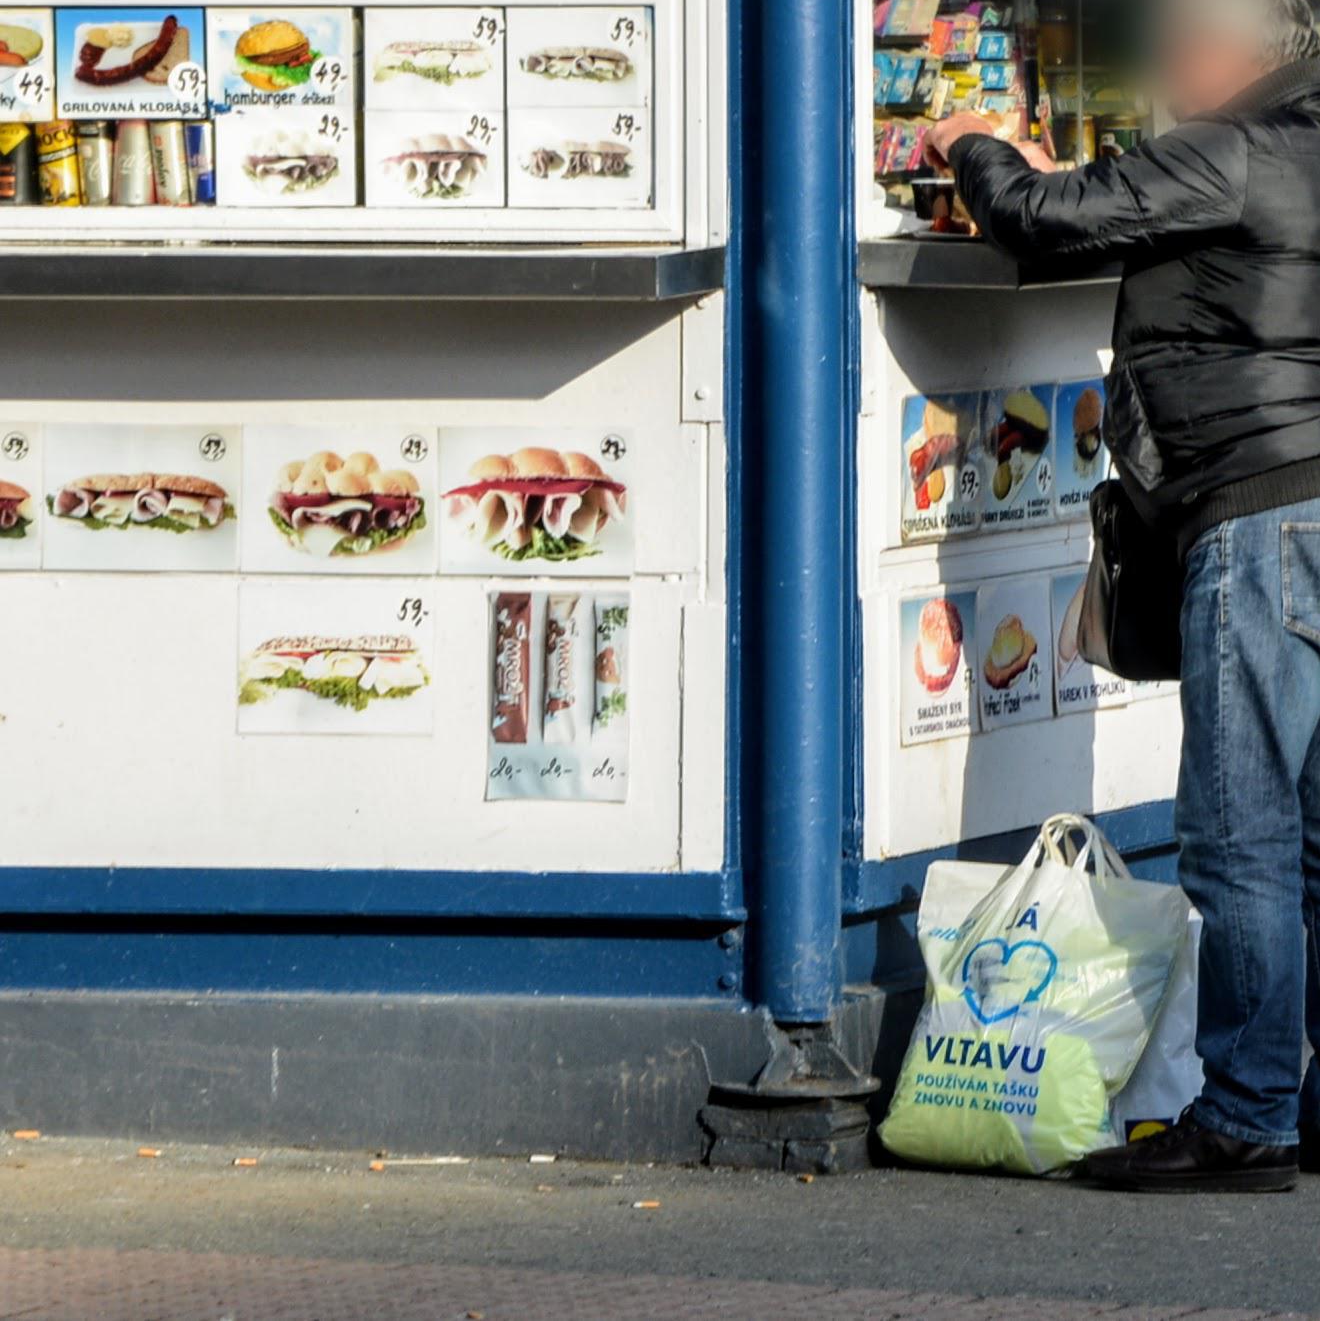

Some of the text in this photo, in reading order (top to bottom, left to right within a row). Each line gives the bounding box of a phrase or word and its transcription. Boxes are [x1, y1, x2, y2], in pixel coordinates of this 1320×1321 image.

[19, 73, 50, 102] 49,-
[176, 69, 206, 98] 59,-
[62, 100, 135, 114] GRILOVANÁ
[224, 88, 296, 109] hamburger
[397, 598, 429, 626] 59,-
[924, 1034, 1047, 1075] VLTAVU
[916, 1073, 1039, 1099] POUŽÍVÁM TAŠKU
[914, 1091, 1037, 1117] ZNOVU A ZNOVU
